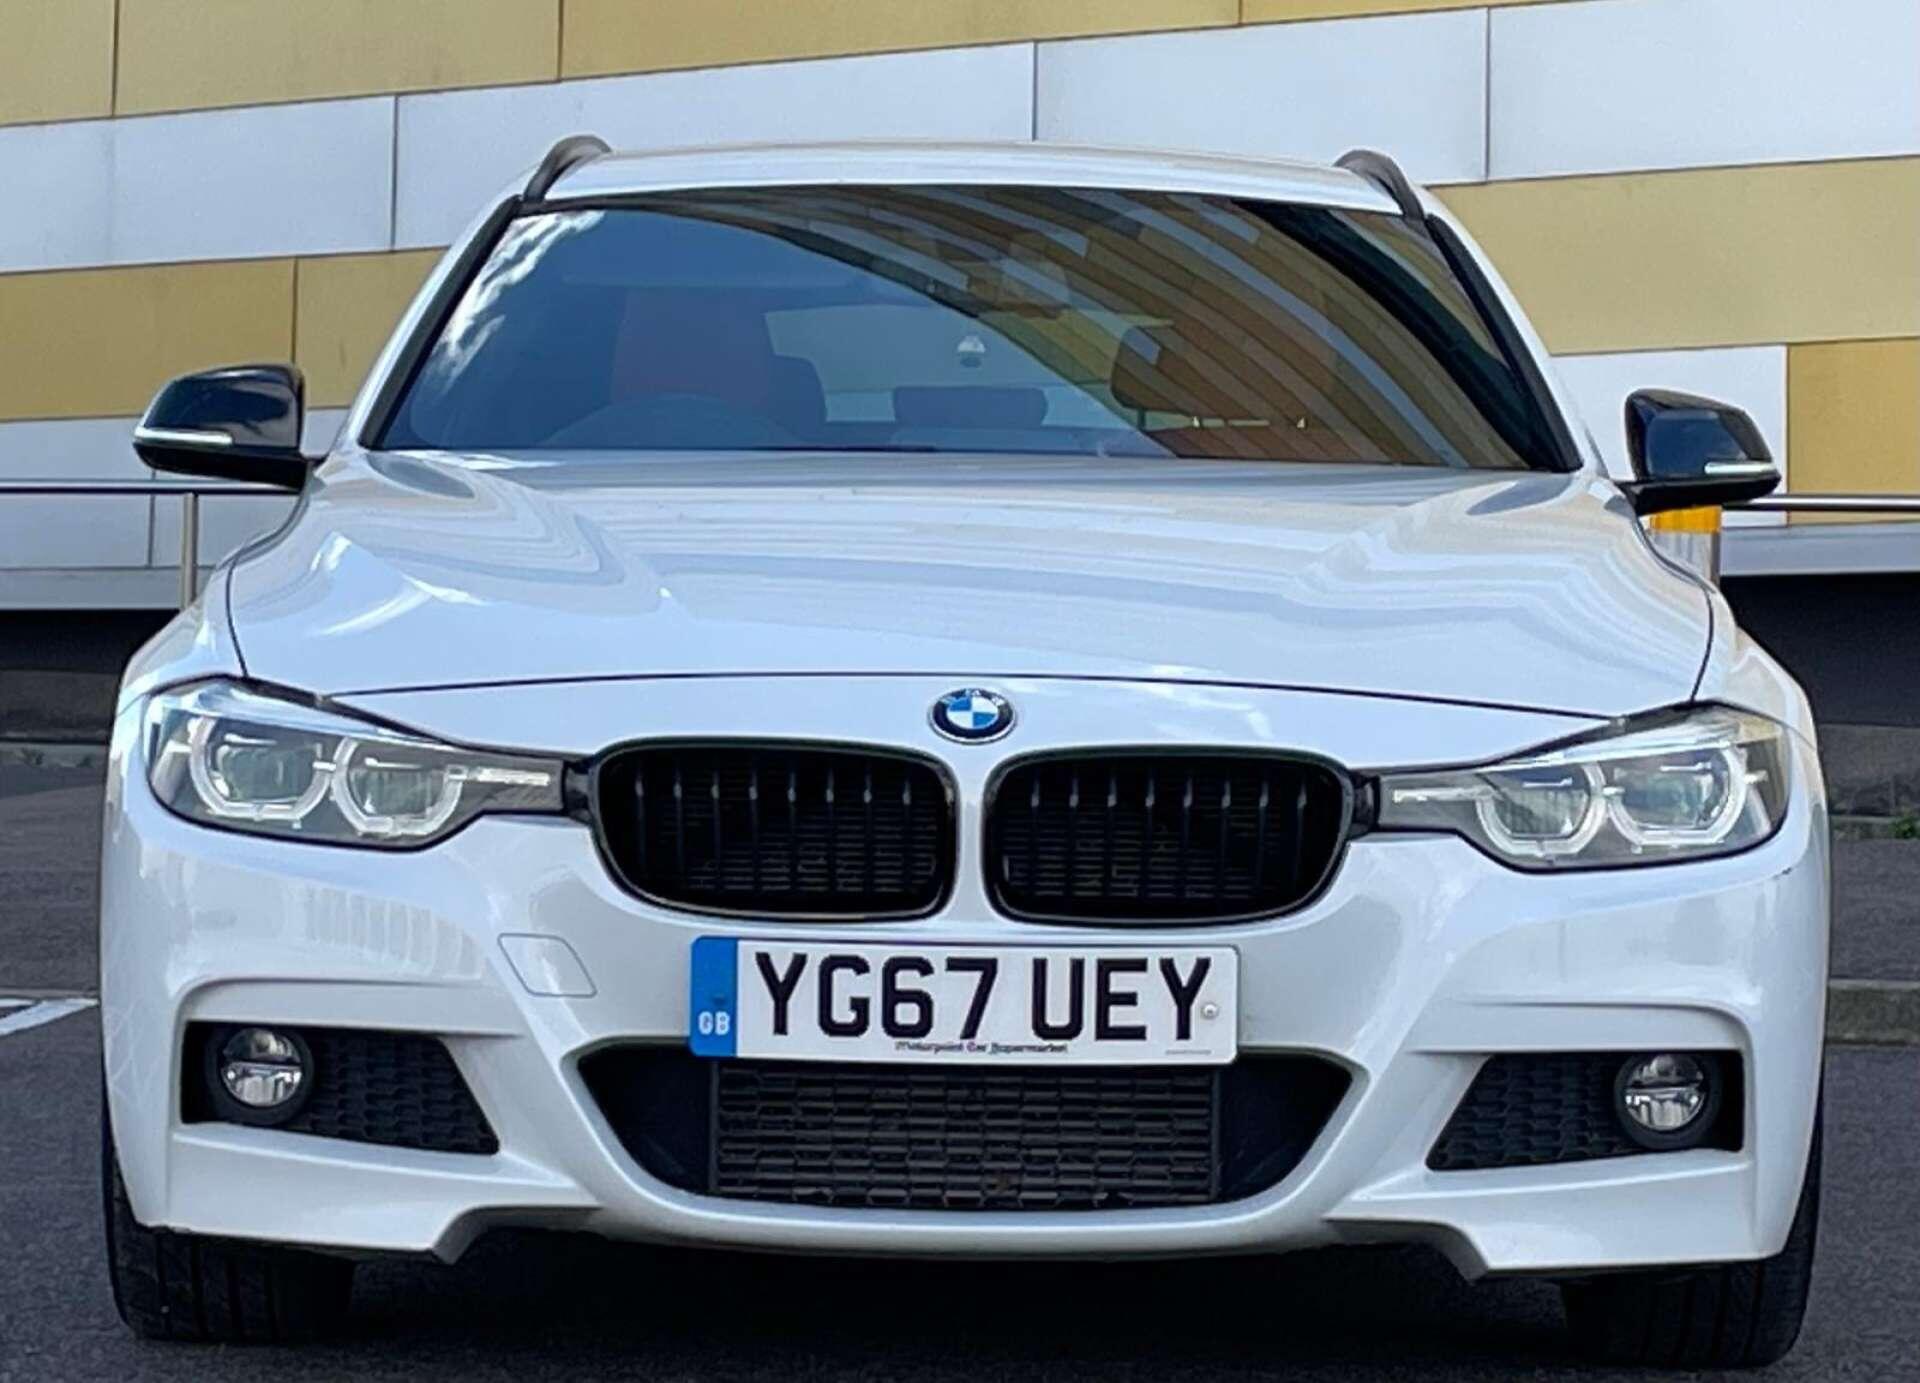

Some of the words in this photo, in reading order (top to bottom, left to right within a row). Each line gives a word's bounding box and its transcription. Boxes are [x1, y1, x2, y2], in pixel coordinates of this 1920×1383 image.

[698, 1011, 731, 1036] GB
[755, 952, 998, 1038] YG67
[1031, 957, 1212, 1041] UEY
